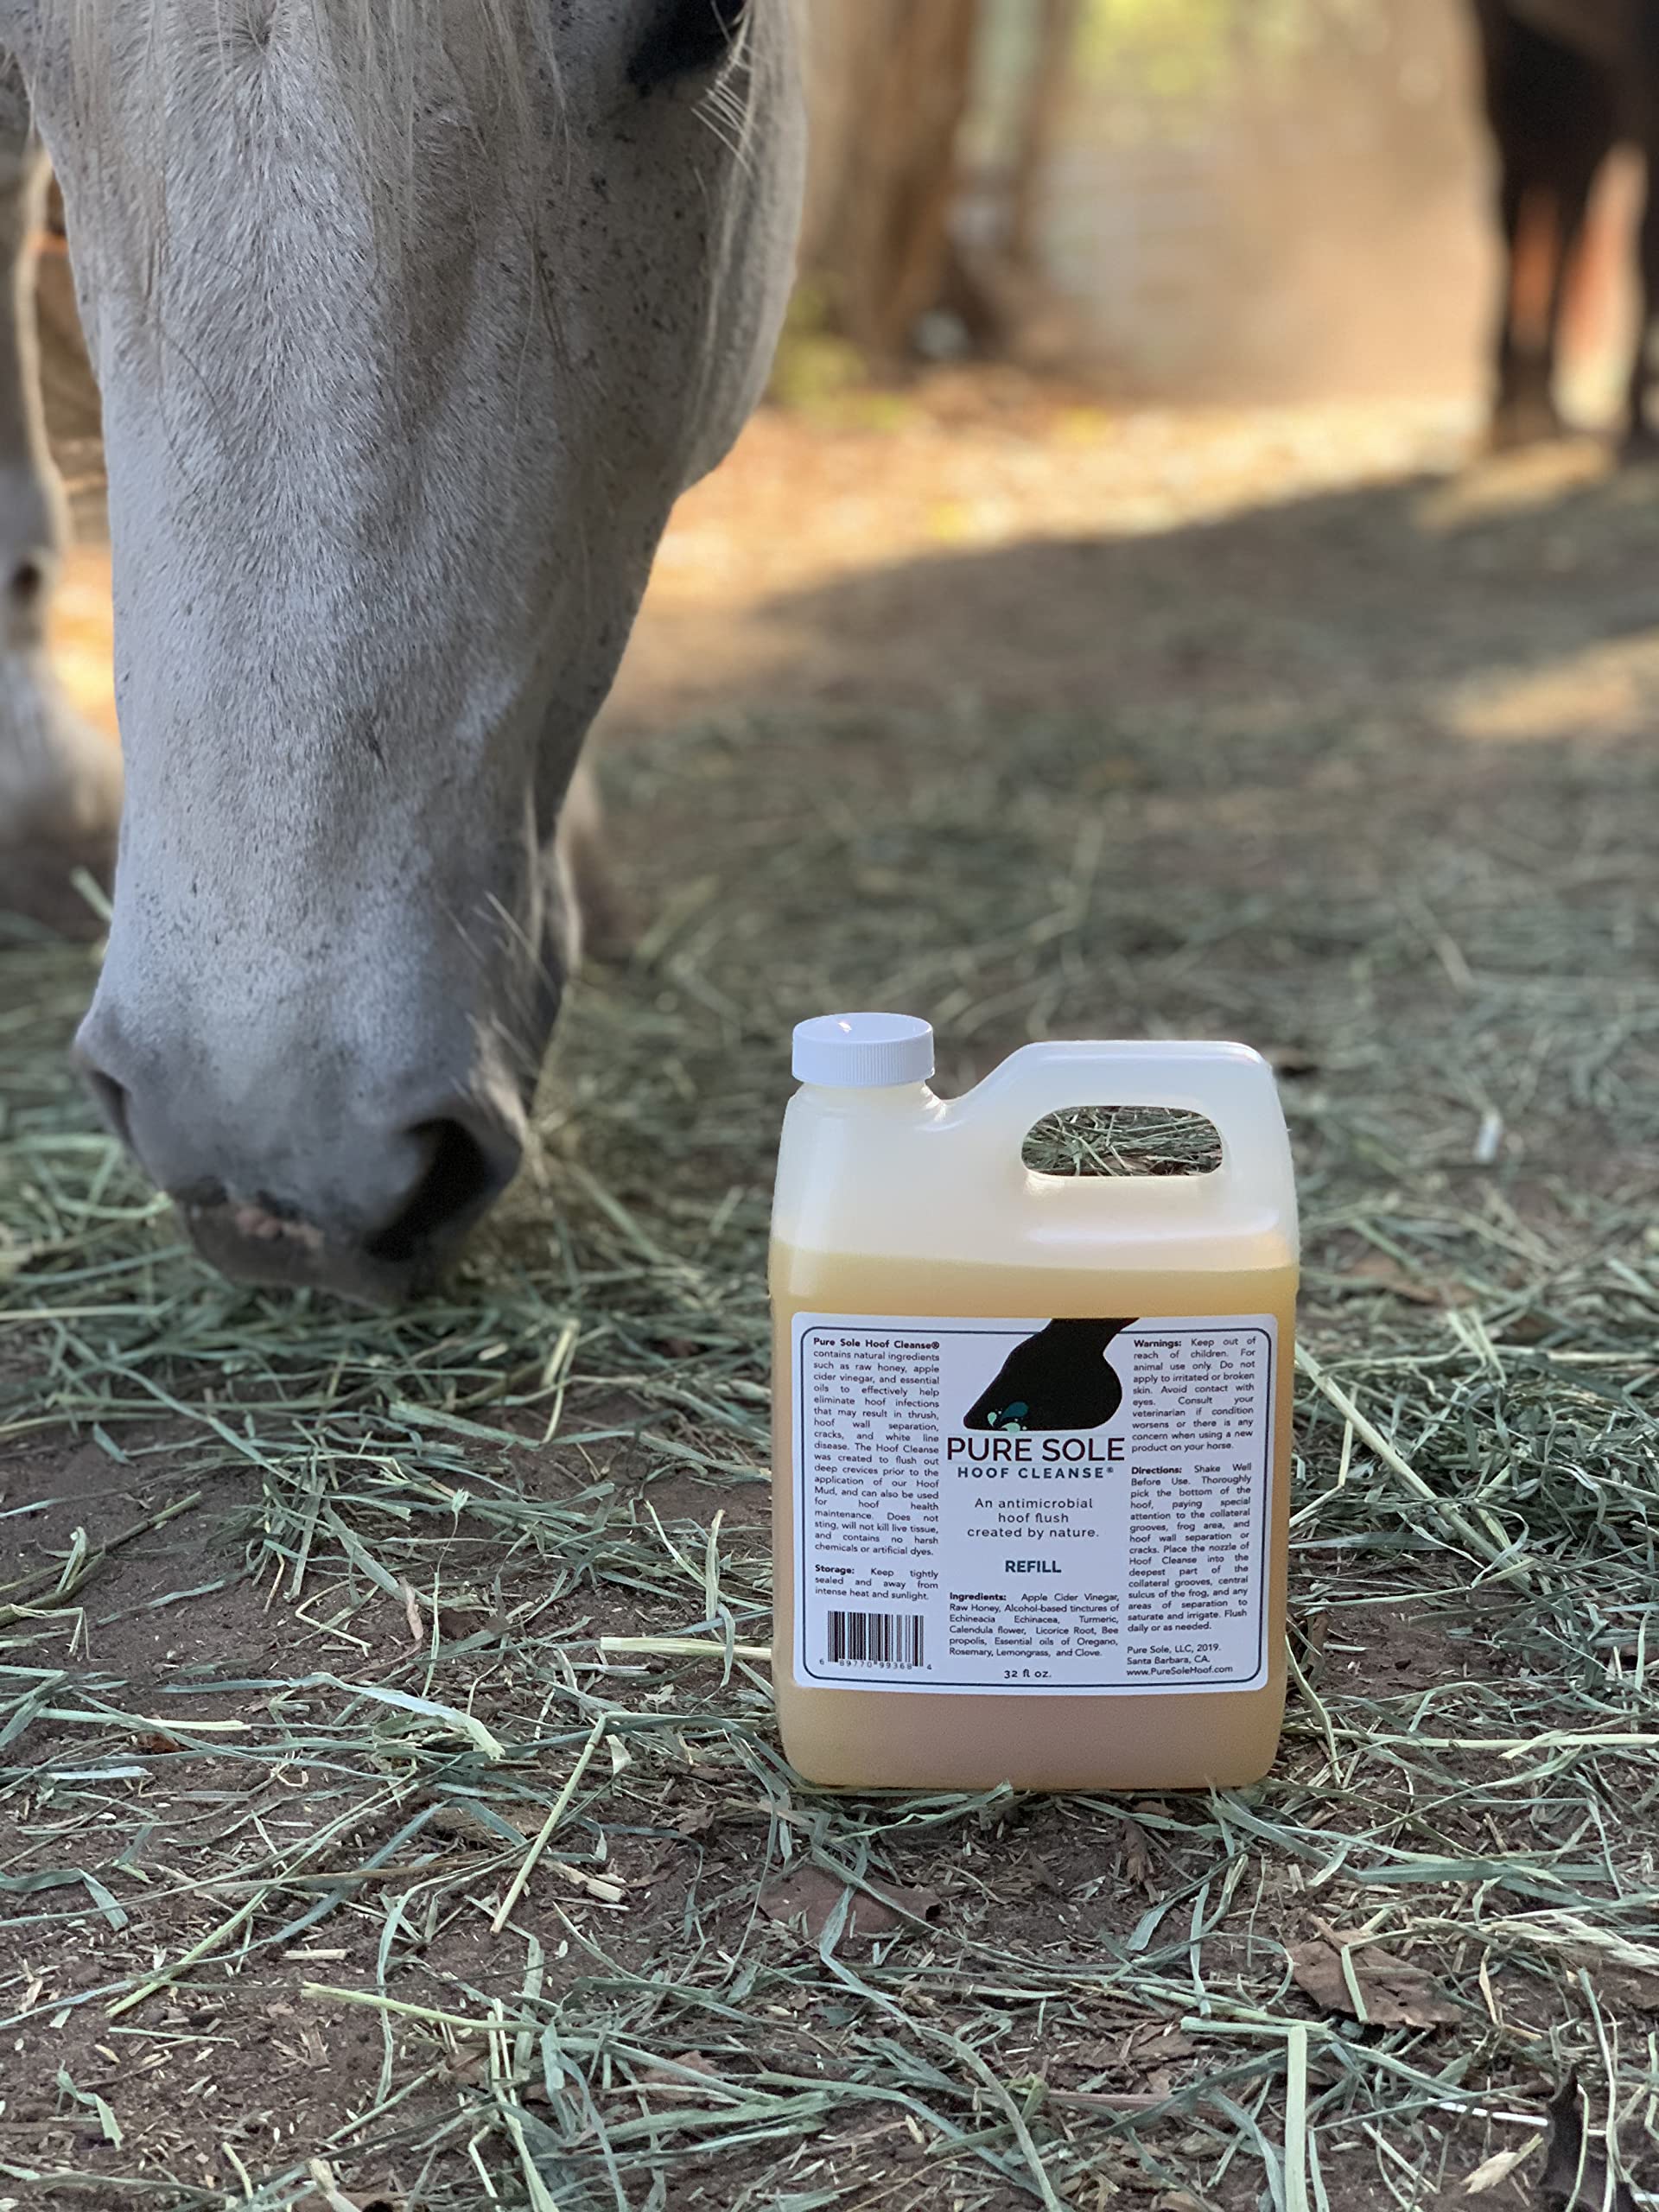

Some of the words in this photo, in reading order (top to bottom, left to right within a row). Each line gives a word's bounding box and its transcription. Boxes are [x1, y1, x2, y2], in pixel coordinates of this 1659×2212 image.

[814, 1338, 835, 1346] Pure
[866, 1339, 889, 1348] Hoof
[1134, 1339, 1181, 1349] Warnings:
[1192, 1338, 1214, 1348] Keep
[1247, 1336, 1256, 1344] of
[888, 1352, 939, 1362] ingredients
[1134, 1351, 1158, 1359] reach
[1170, 1350, 1179, 1358] of
[1191, 1350, 1229, 1358] children.
[1241, 1348, 1255, 1357] For
[814, 1372, 836, 1381] cider
[840, 1374, 874, 1384] vinegar,
[861, 1385, 907, 1397] effectively
[919, 1388, 939, 1398] help
[1133, 1386, 1153, 1395] skin.
[1236, 1382, 1255, 1391] with
[814, 1395, 855, 1405] eliminate
[865, 1397, 886, 1406] hoof
[896, 1398, 939, 1408] infections
[1133, 1400, 1155, 1408] eyes.
[1178, 1396, 1212, 1405] Consult
[1234, 1396, 1254, 1405] your
[1133, 1408, 1185, 1417] veterinarian
[1196, 1407, 1202, 1415] if
[1211, 1407, 1254, 1415] condition
[814, 1417, 835, 1427] hoof
[888, 1423, 938, 1432] separation,
[814, 1440, 849, 1450] disease.
[855, 1443, 871, 1452] The
[903, 1445, 938, 1453] Cleanse
[948, 1438, 1032, 1461] PURE
[1042, 1438, 1125, 1462] SOLE
[1132, 1443, 1167, 1453] product
[1206, 1441, 1233, 1450] horse.
[958, 1467, 1008, 1478] HOOF
[1232, 1462, 1251, 1471] Well
[814, 1476, 864, 1484] application
[873, 1478, 882, 1486] of
[916, 1479, 939, 1488] Hoof
[1131, 1478, 1160, 1486] Before
[1201, 1474, 1251, 1484] Thoroughly
[815, 1497, 827, 1505] for
[911, 1502, 938, 1510] health
[975, 1498, 992, 1508] An
[999, 1498, 1092, 1509] antimicrobial
[1130, 1500, 1154, 1510] hoof,
[1173, 1500, 1202, 1510] paying
[1220, 1497, 1250, 1507] special
[999, 1513, 1030, 1522] hoof
[1035, 1513, 1068, 1522] flush
[968, 1528, 1021, 1537] created
[1028, 1528, 1044, 1540] by
[1050, 1528, 1098, 1537] nature.
[1185, 1533, 1231, 1542] separation
[815, 1541, 858, 1552] chemicals
[873, 1546, 907, 1554] artificial
[911, 1547, 933, 1557] dyes.
[1235, 1553, 1249, 1561] the
[816, 1564, 855, 1575] Storage:
[871, 1567, 893, 1577] Keep
[910, 1570, 938, 1580] tightly
[1006, 1560, 1061, 1573] REFILL
[816, 1576, 843, 1585] sealed
[883, 1581, 906, 1590] away
[1128, 1579, 1169, 1587] collateral
[1174, 1580, 1212, 1588] grooves,
[1218, 1576, 1248, 1585] central
[816, 1586, 847, 1596] intense
[850, 1588, 869, 1597] heat
[872, 1590, 888, 1599] and
[892, 1592, 928, 1601] sunlight.
[950, 1592, 1006, 1602] Ingredients:
[1021, 1593, 1047, 1602] Apple
[1084, 1593, 1119, 1603] Vinegar,
[971, 1604, 1001, 1614] Honey,
[1004, 1604, 1067, 1612] Alcohol-based
[1224, 1609, 1247, 1618] Flush
[1014, 1616, 1060, 1624] Echinacea,
[998, 1626, 1027, 1635] flower,
[1036, 1626, 1069, 1635] Licorice
[1074, 1626, 1096, 1635] Root,
[1128, 1624, 1148, 1634] daily
[1175, 1621, 1211, 1630] needed.
[950, 1637, 987, 1645] propolis,
[995, 1637, 1032, 1645] Essential
[1077, 1637, 1118, 1647] Oregano,
[950, 1647, 994, 1657] Rosemary,
[996, 1649, 1051, 1658] Lemongrass,
[1150, 1645, 1172, 1654] Sole,
[1175, 1644, 1194, 1654] LLC,
[839, 1659, 873, 1669] 89770
[1127, 1665, 1233, 1675] www.PureSoleHoof.com
[1004, 1670, 1018, 1679] 32
